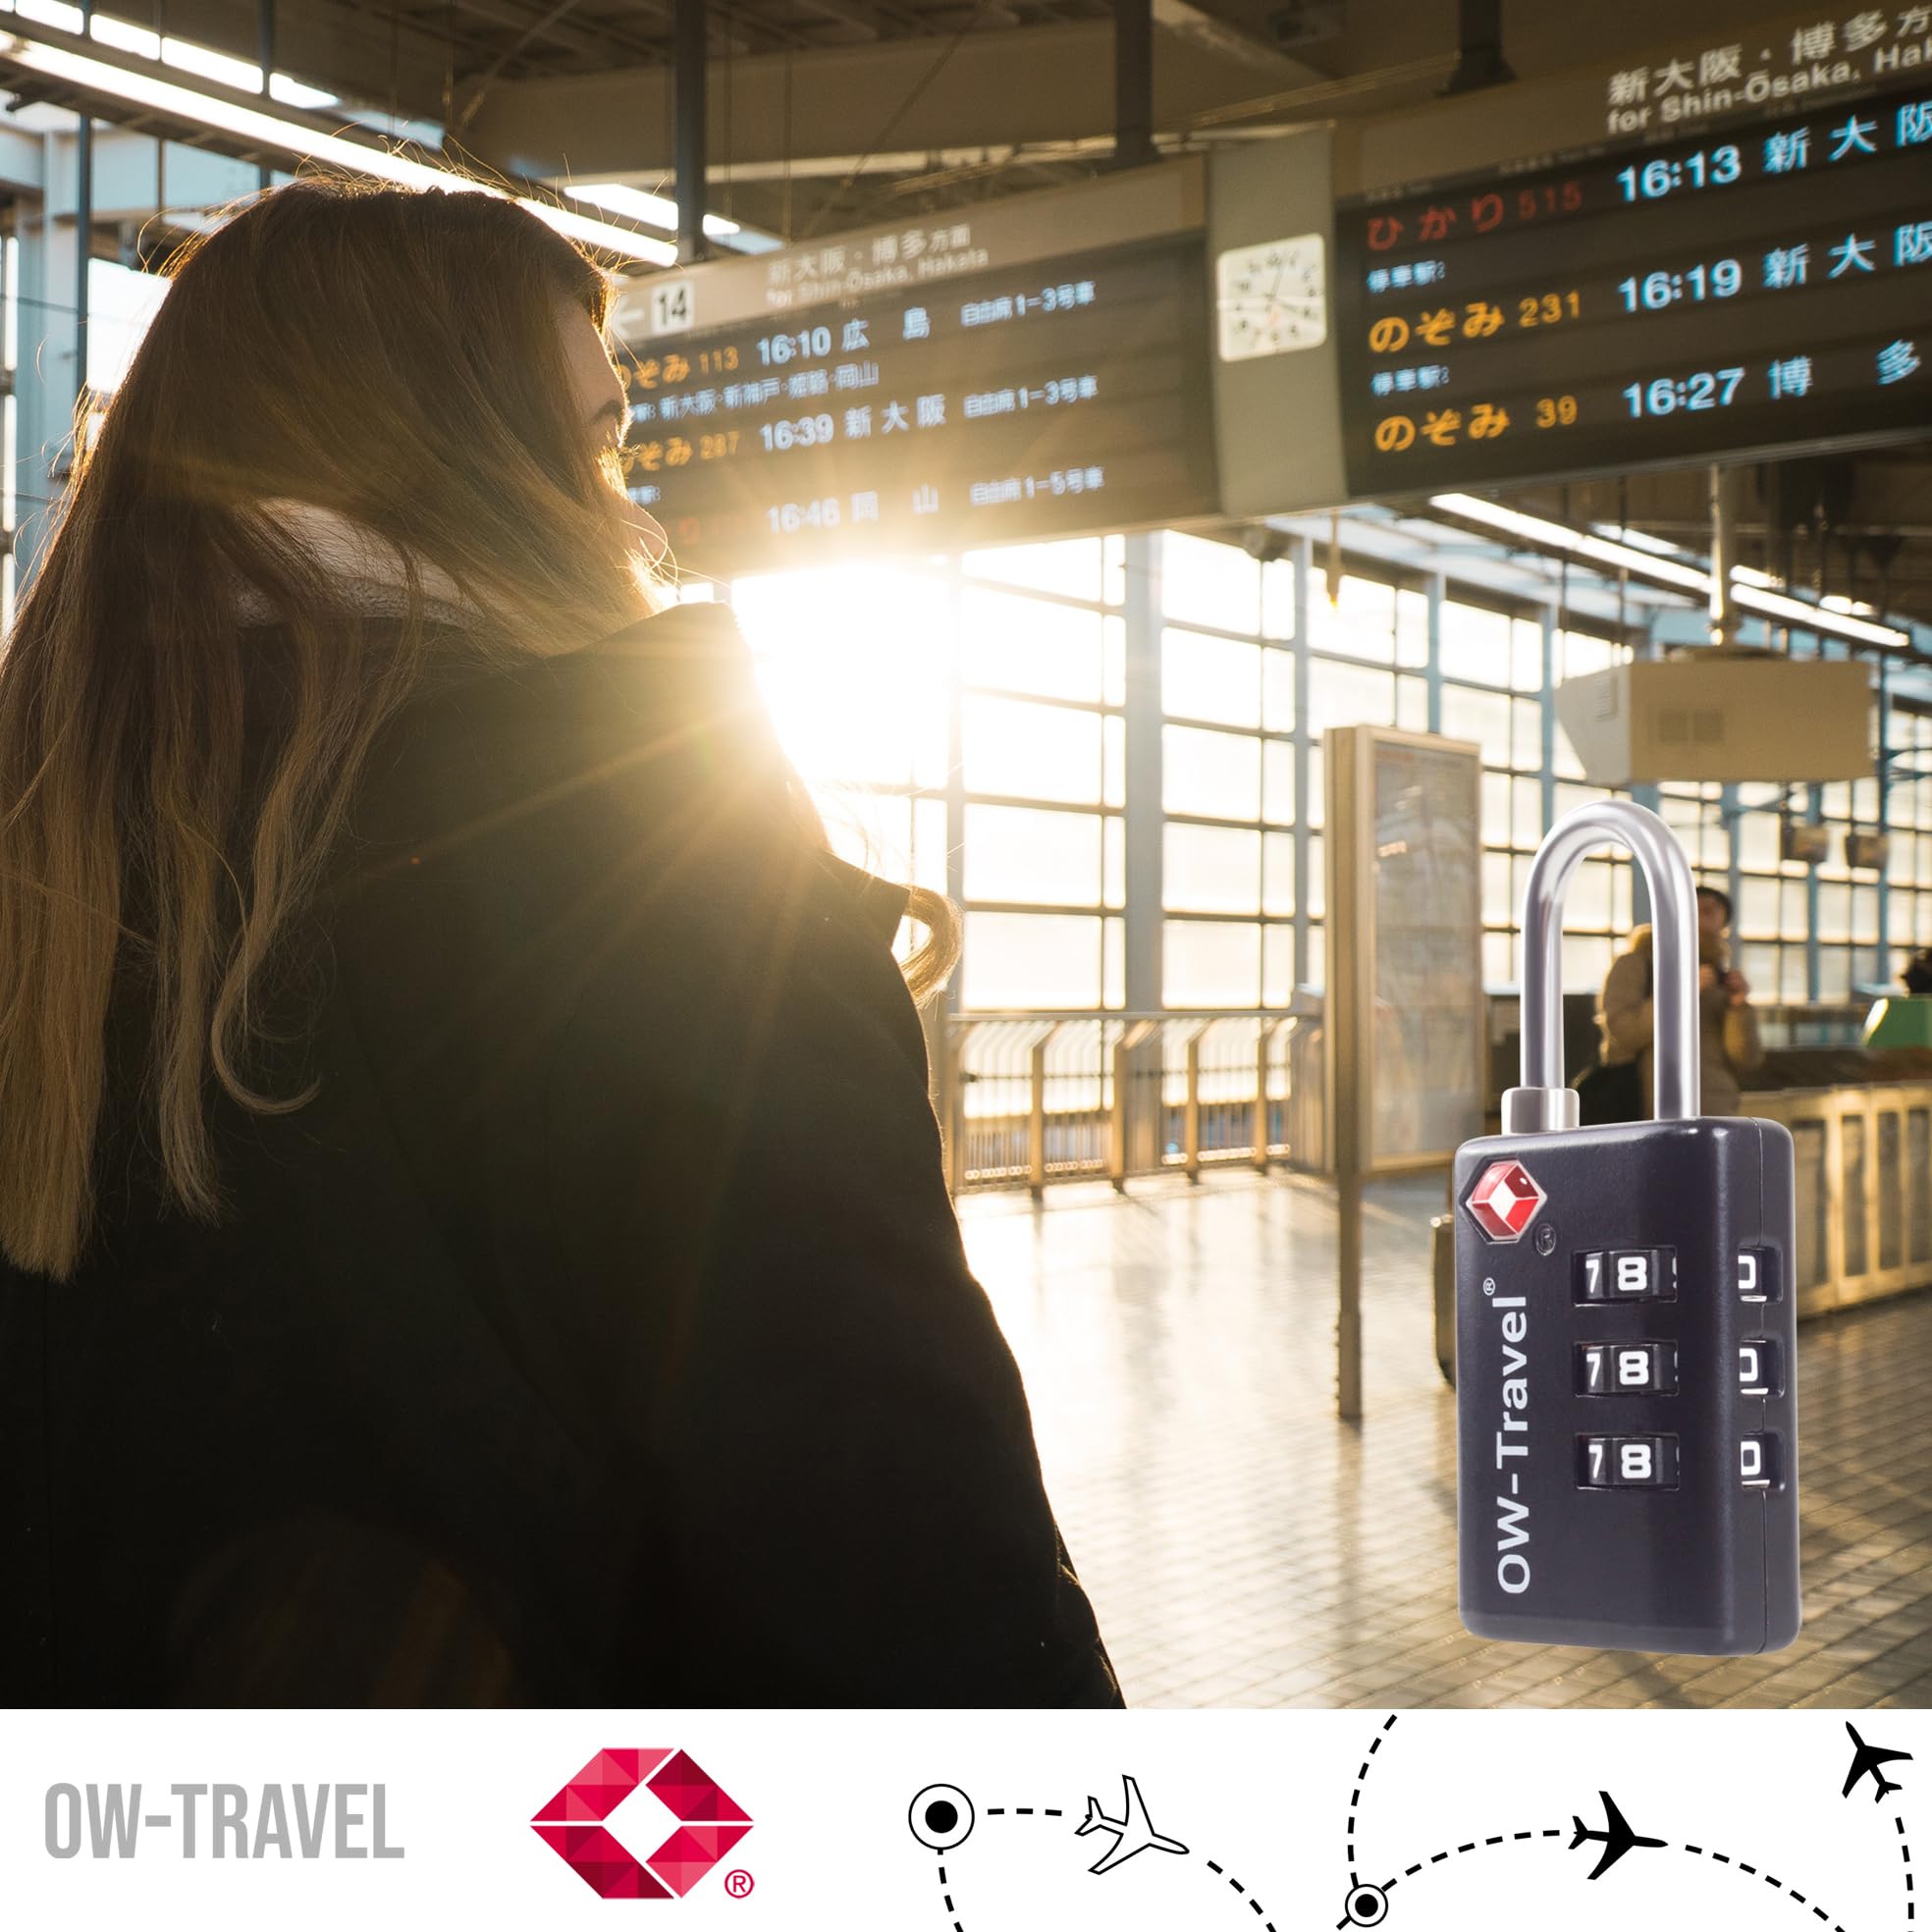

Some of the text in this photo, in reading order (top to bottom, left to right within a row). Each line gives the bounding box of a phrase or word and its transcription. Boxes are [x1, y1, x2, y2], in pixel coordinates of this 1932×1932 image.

[1607, 102, 1653, 134] for
[1368, 193, 1505, 251] ひかり
[1519, 181, 1583, 220] 515
[1617, 144, 1743, 202] 16:13
[659, 289, 687, 327] 14
[1369, 301, 1506, 353] のぞみ
[1519, 291, 1581, 328] 231
[1618, 259, 1743, 312] 16:19
[699, 346, 738, 374] 113
[756, 326, 832, 366] 16:10
[1375, 402, 1510, 452] のぞみ
[1536, 395, 1578, 429] 39
[1623, 367, 1745, 418] 16:27
[761, 413, 833, 451] 16:39
[768, 497, 840, 535] 16:46
